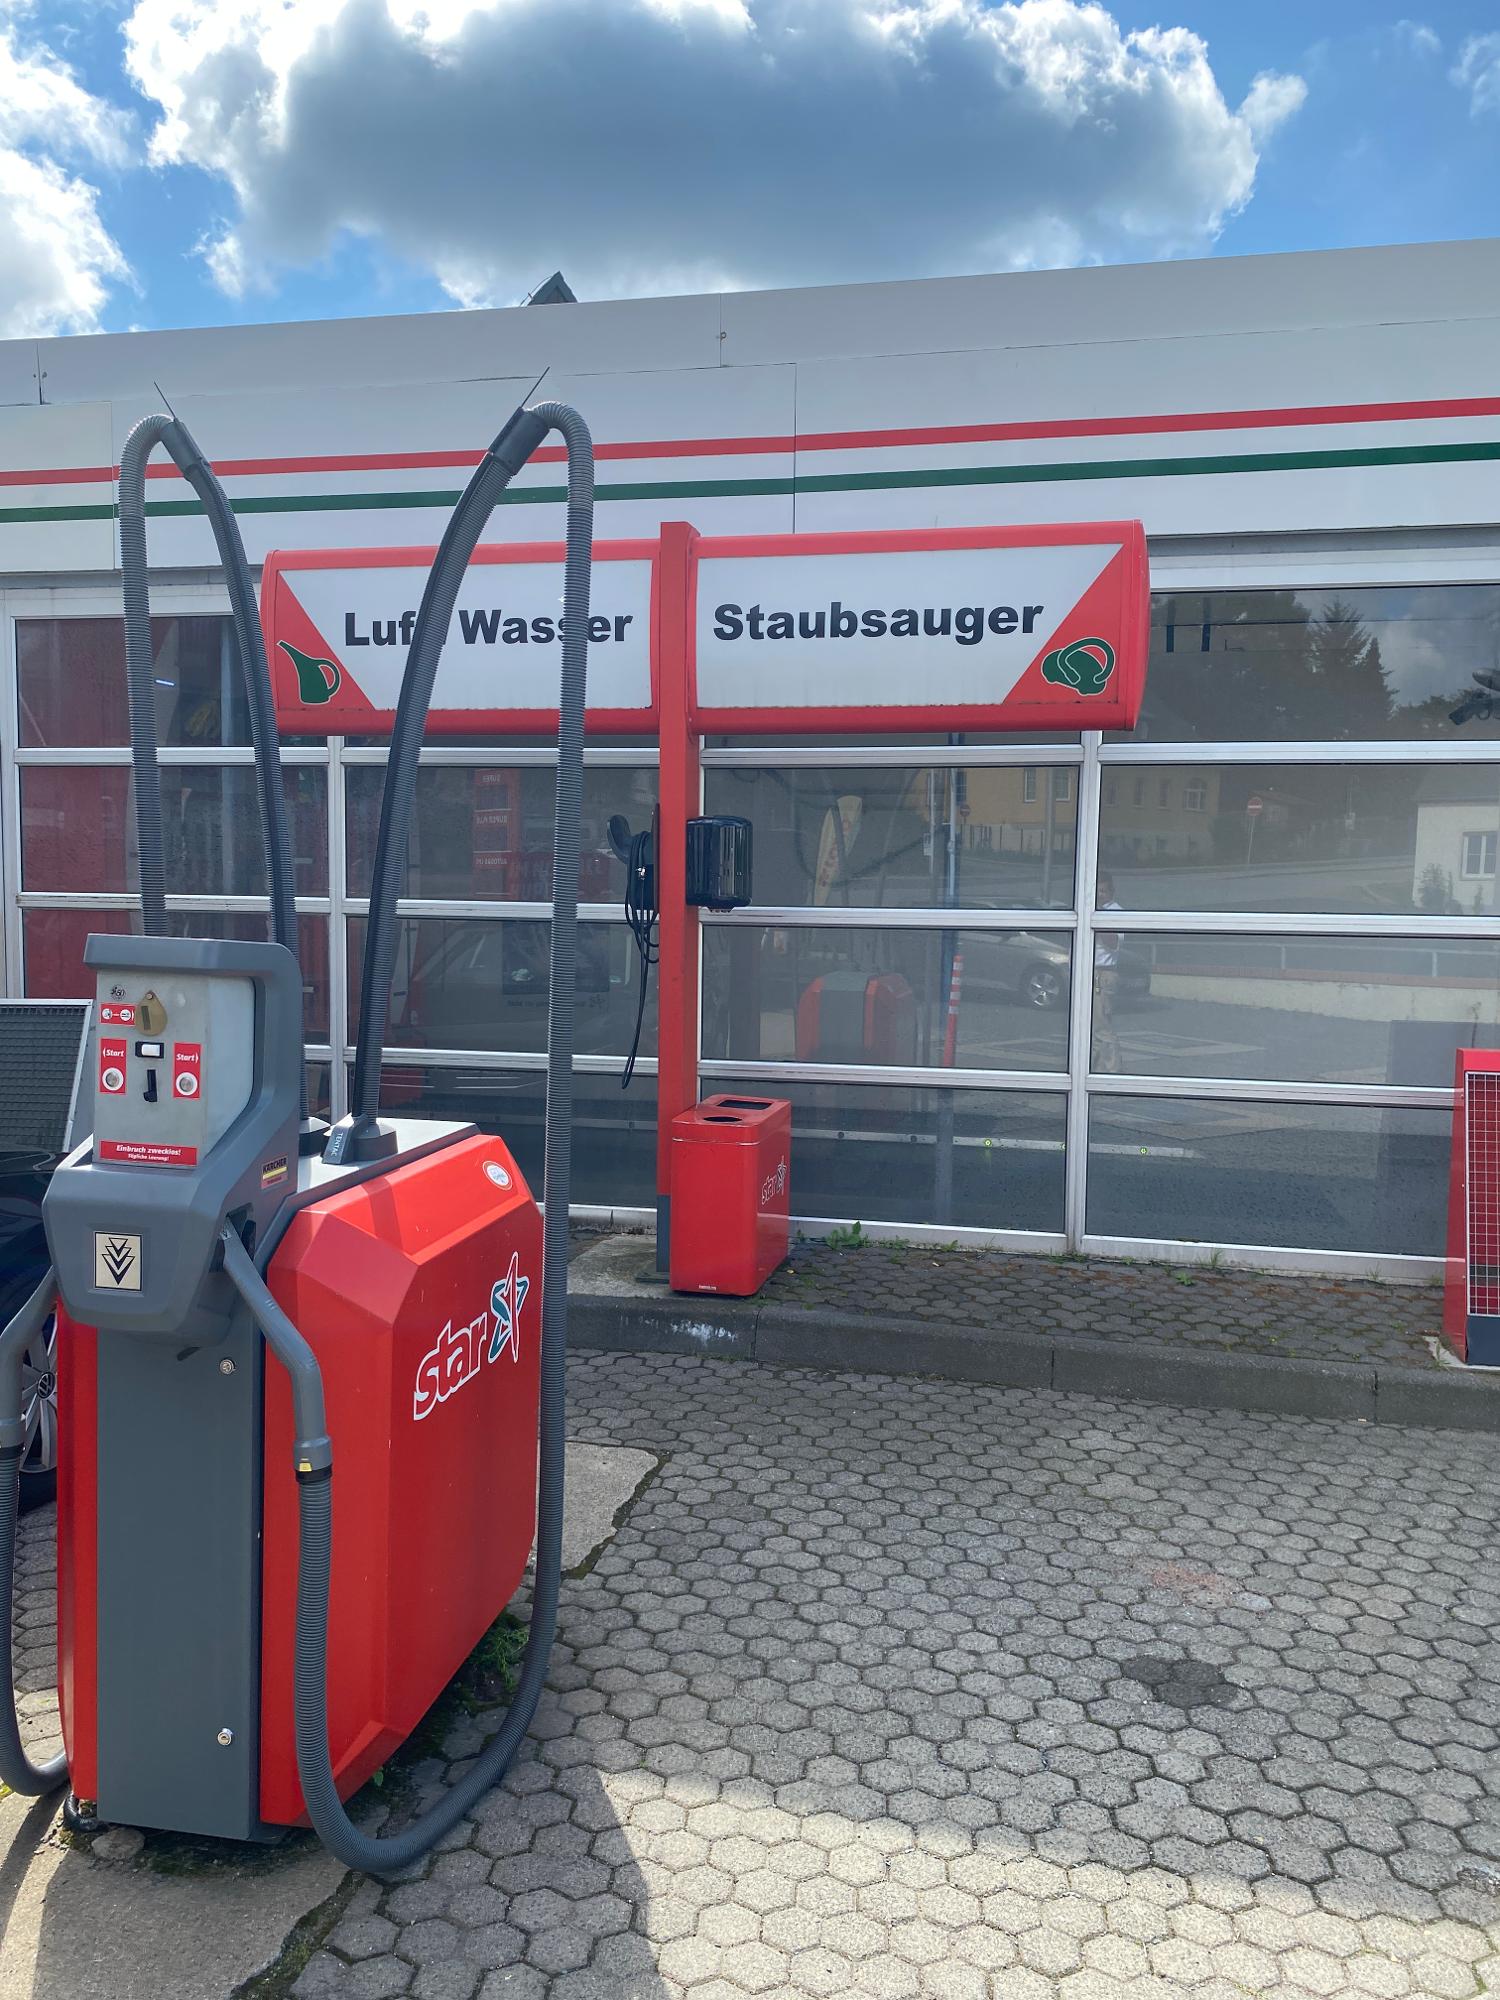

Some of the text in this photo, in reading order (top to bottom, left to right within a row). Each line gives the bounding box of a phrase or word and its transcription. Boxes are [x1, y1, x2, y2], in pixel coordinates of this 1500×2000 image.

[345, 610, 420, 646] Luf
[713, 601, 1044, 646] Staubsauger
[116, 1144, 182, 1156] Einbruch zwecklos!
[414, 1312, 488, 1421] star
